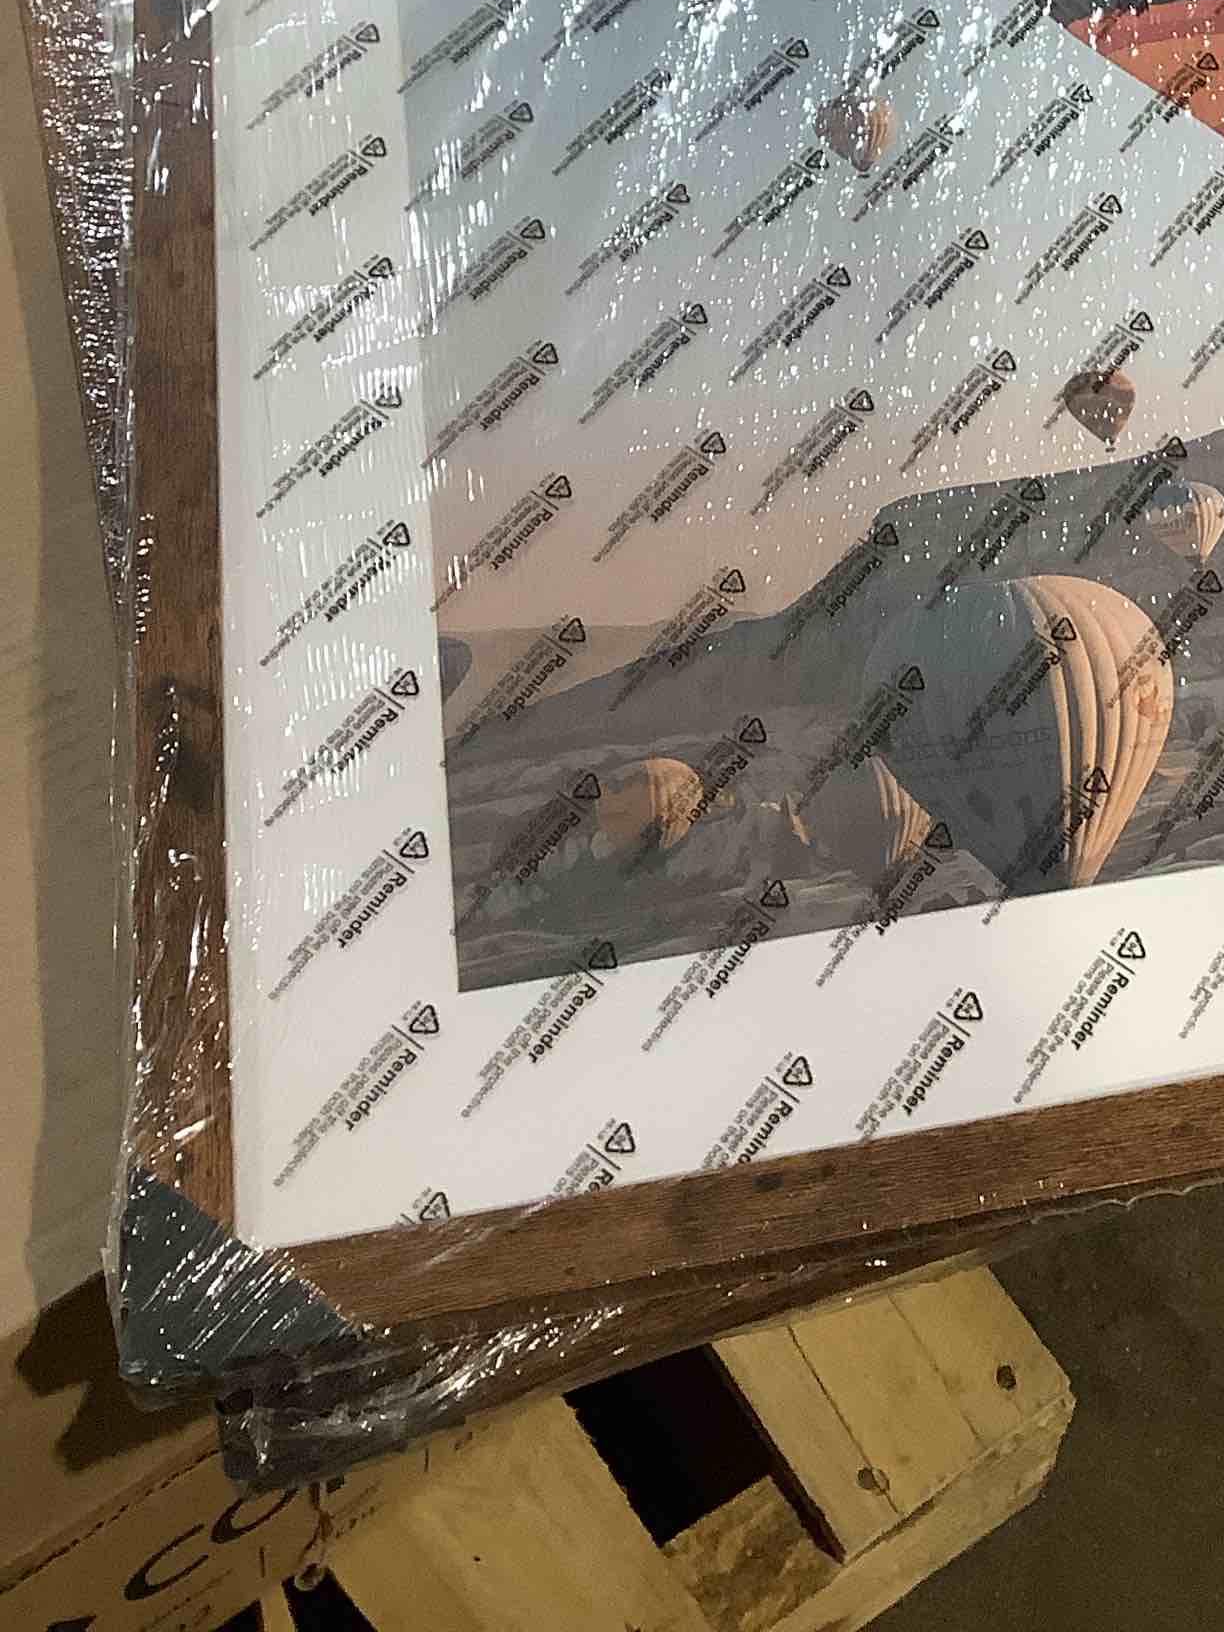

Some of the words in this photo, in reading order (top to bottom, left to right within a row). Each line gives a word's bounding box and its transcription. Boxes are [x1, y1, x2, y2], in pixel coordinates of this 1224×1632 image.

[336, 872, 407, 947] Reminder
[528, 983, 597, 1062] Reminder
[1071, 972, 1129, 1049] Reminder
[343, 1048, 417, 1130] Reminder
[902, 1034, 965, 1114] Reminder
